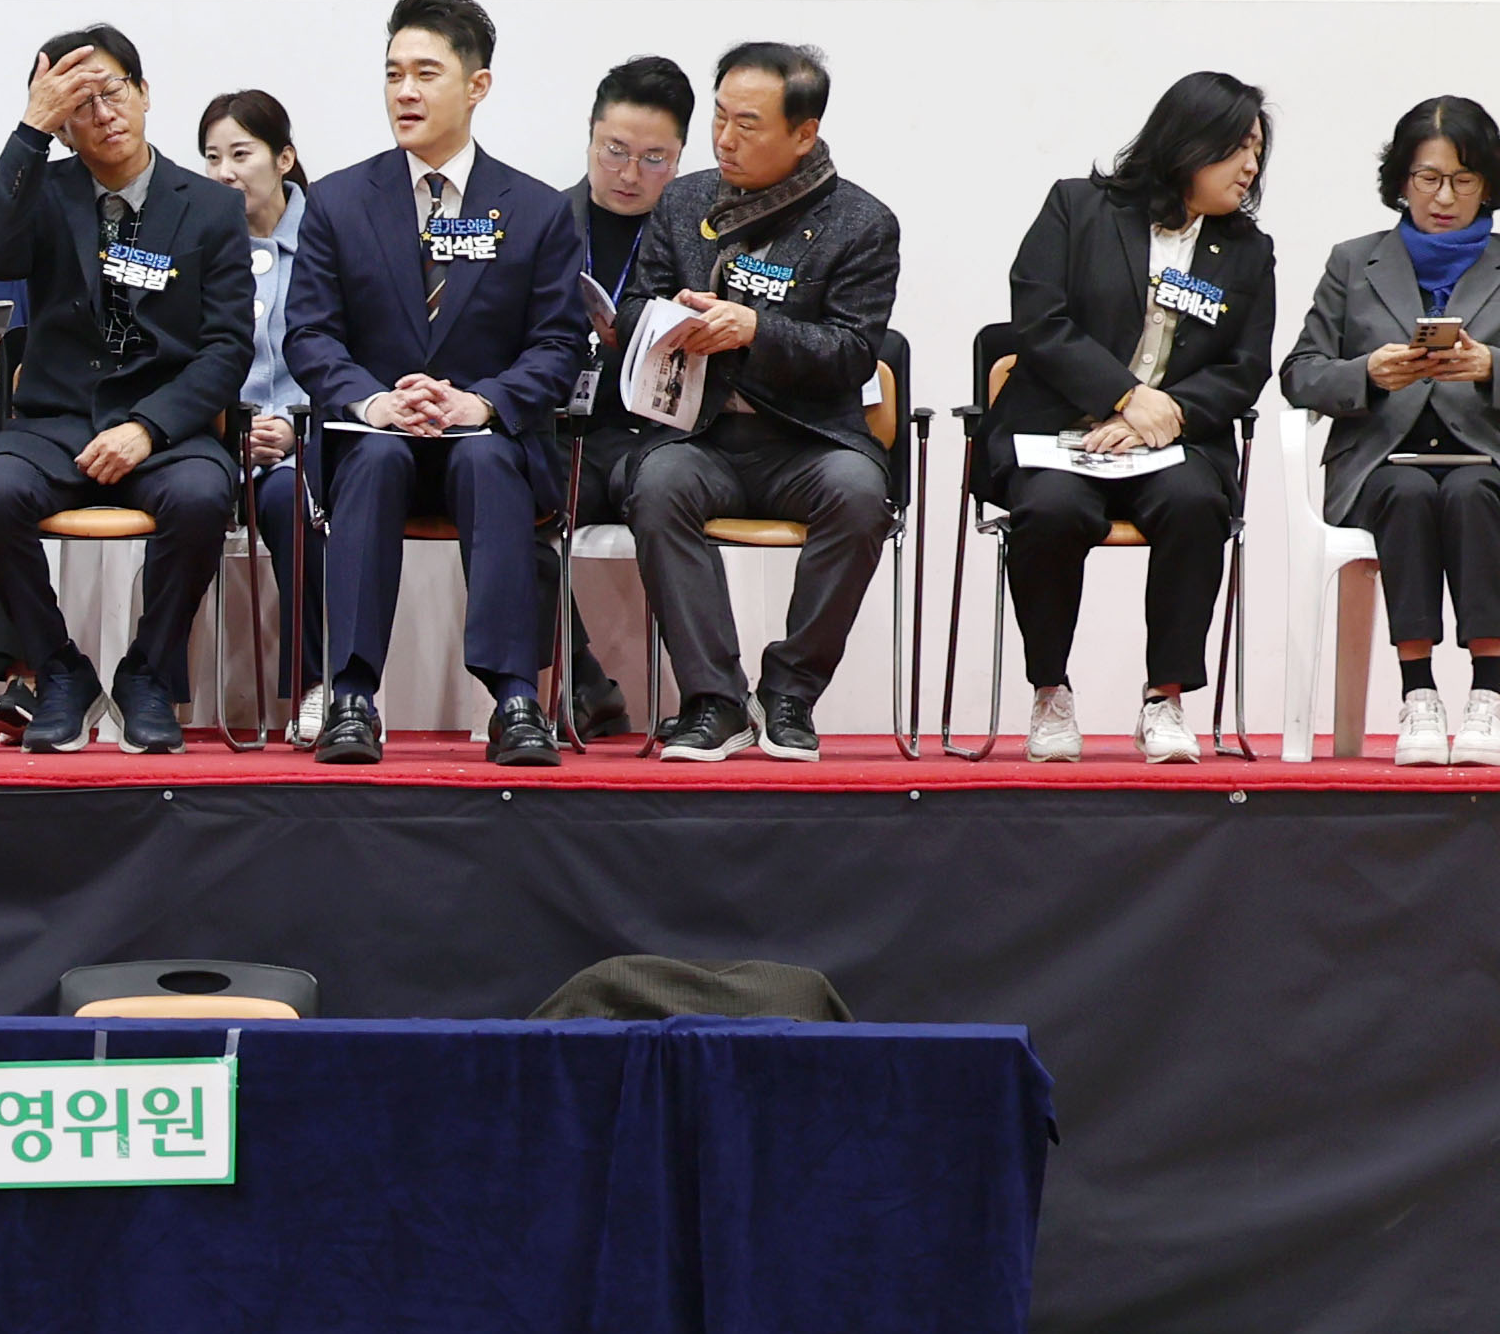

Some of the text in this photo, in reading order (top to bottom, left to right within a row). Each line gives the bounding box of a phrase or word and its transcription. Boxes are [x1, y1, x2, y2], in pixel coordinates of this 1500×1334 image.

[429, 218, 494, 235] 경기도의원
[108, 242, 172, 270] 경기도의원
[430, 234, 497, 261] 전석훈
[102, 256, 169, 291] 국중범
[727, 267, 789, 302] 조우현
[1155, 281, 1221, 325] 윤혜선
